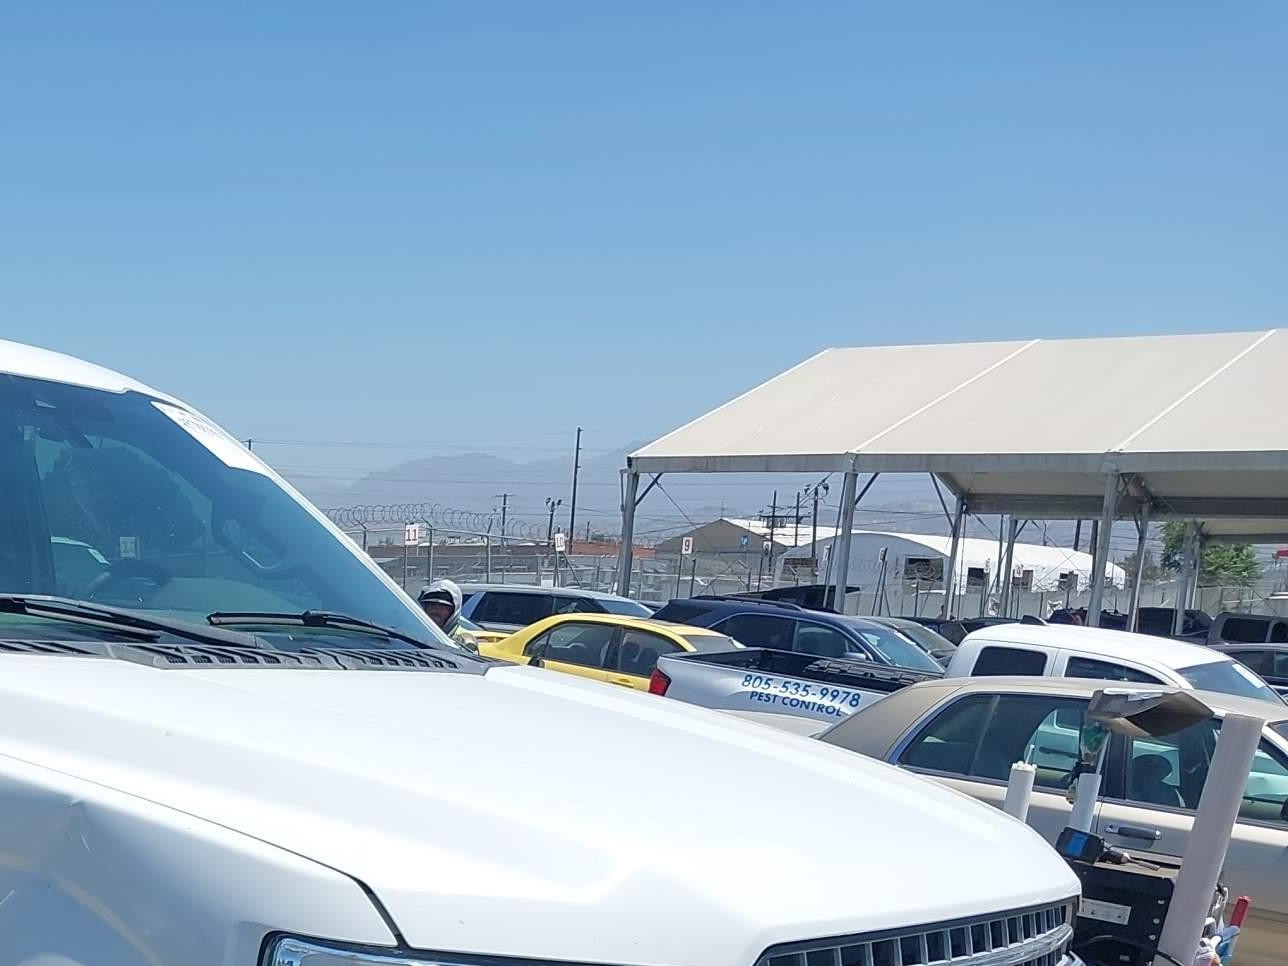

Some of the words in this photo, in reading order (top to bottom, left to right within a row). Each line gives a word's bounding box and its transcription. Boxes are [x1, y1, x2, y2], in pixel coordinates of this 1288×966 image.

[405, 528, 418, 542] 11
[684, 539, 691, 552] 9
[741, 674, 862, 708] 805-535-9978
[750, 690, 778, 705] PEST
[781, 696, 843, 717] CONTROL
